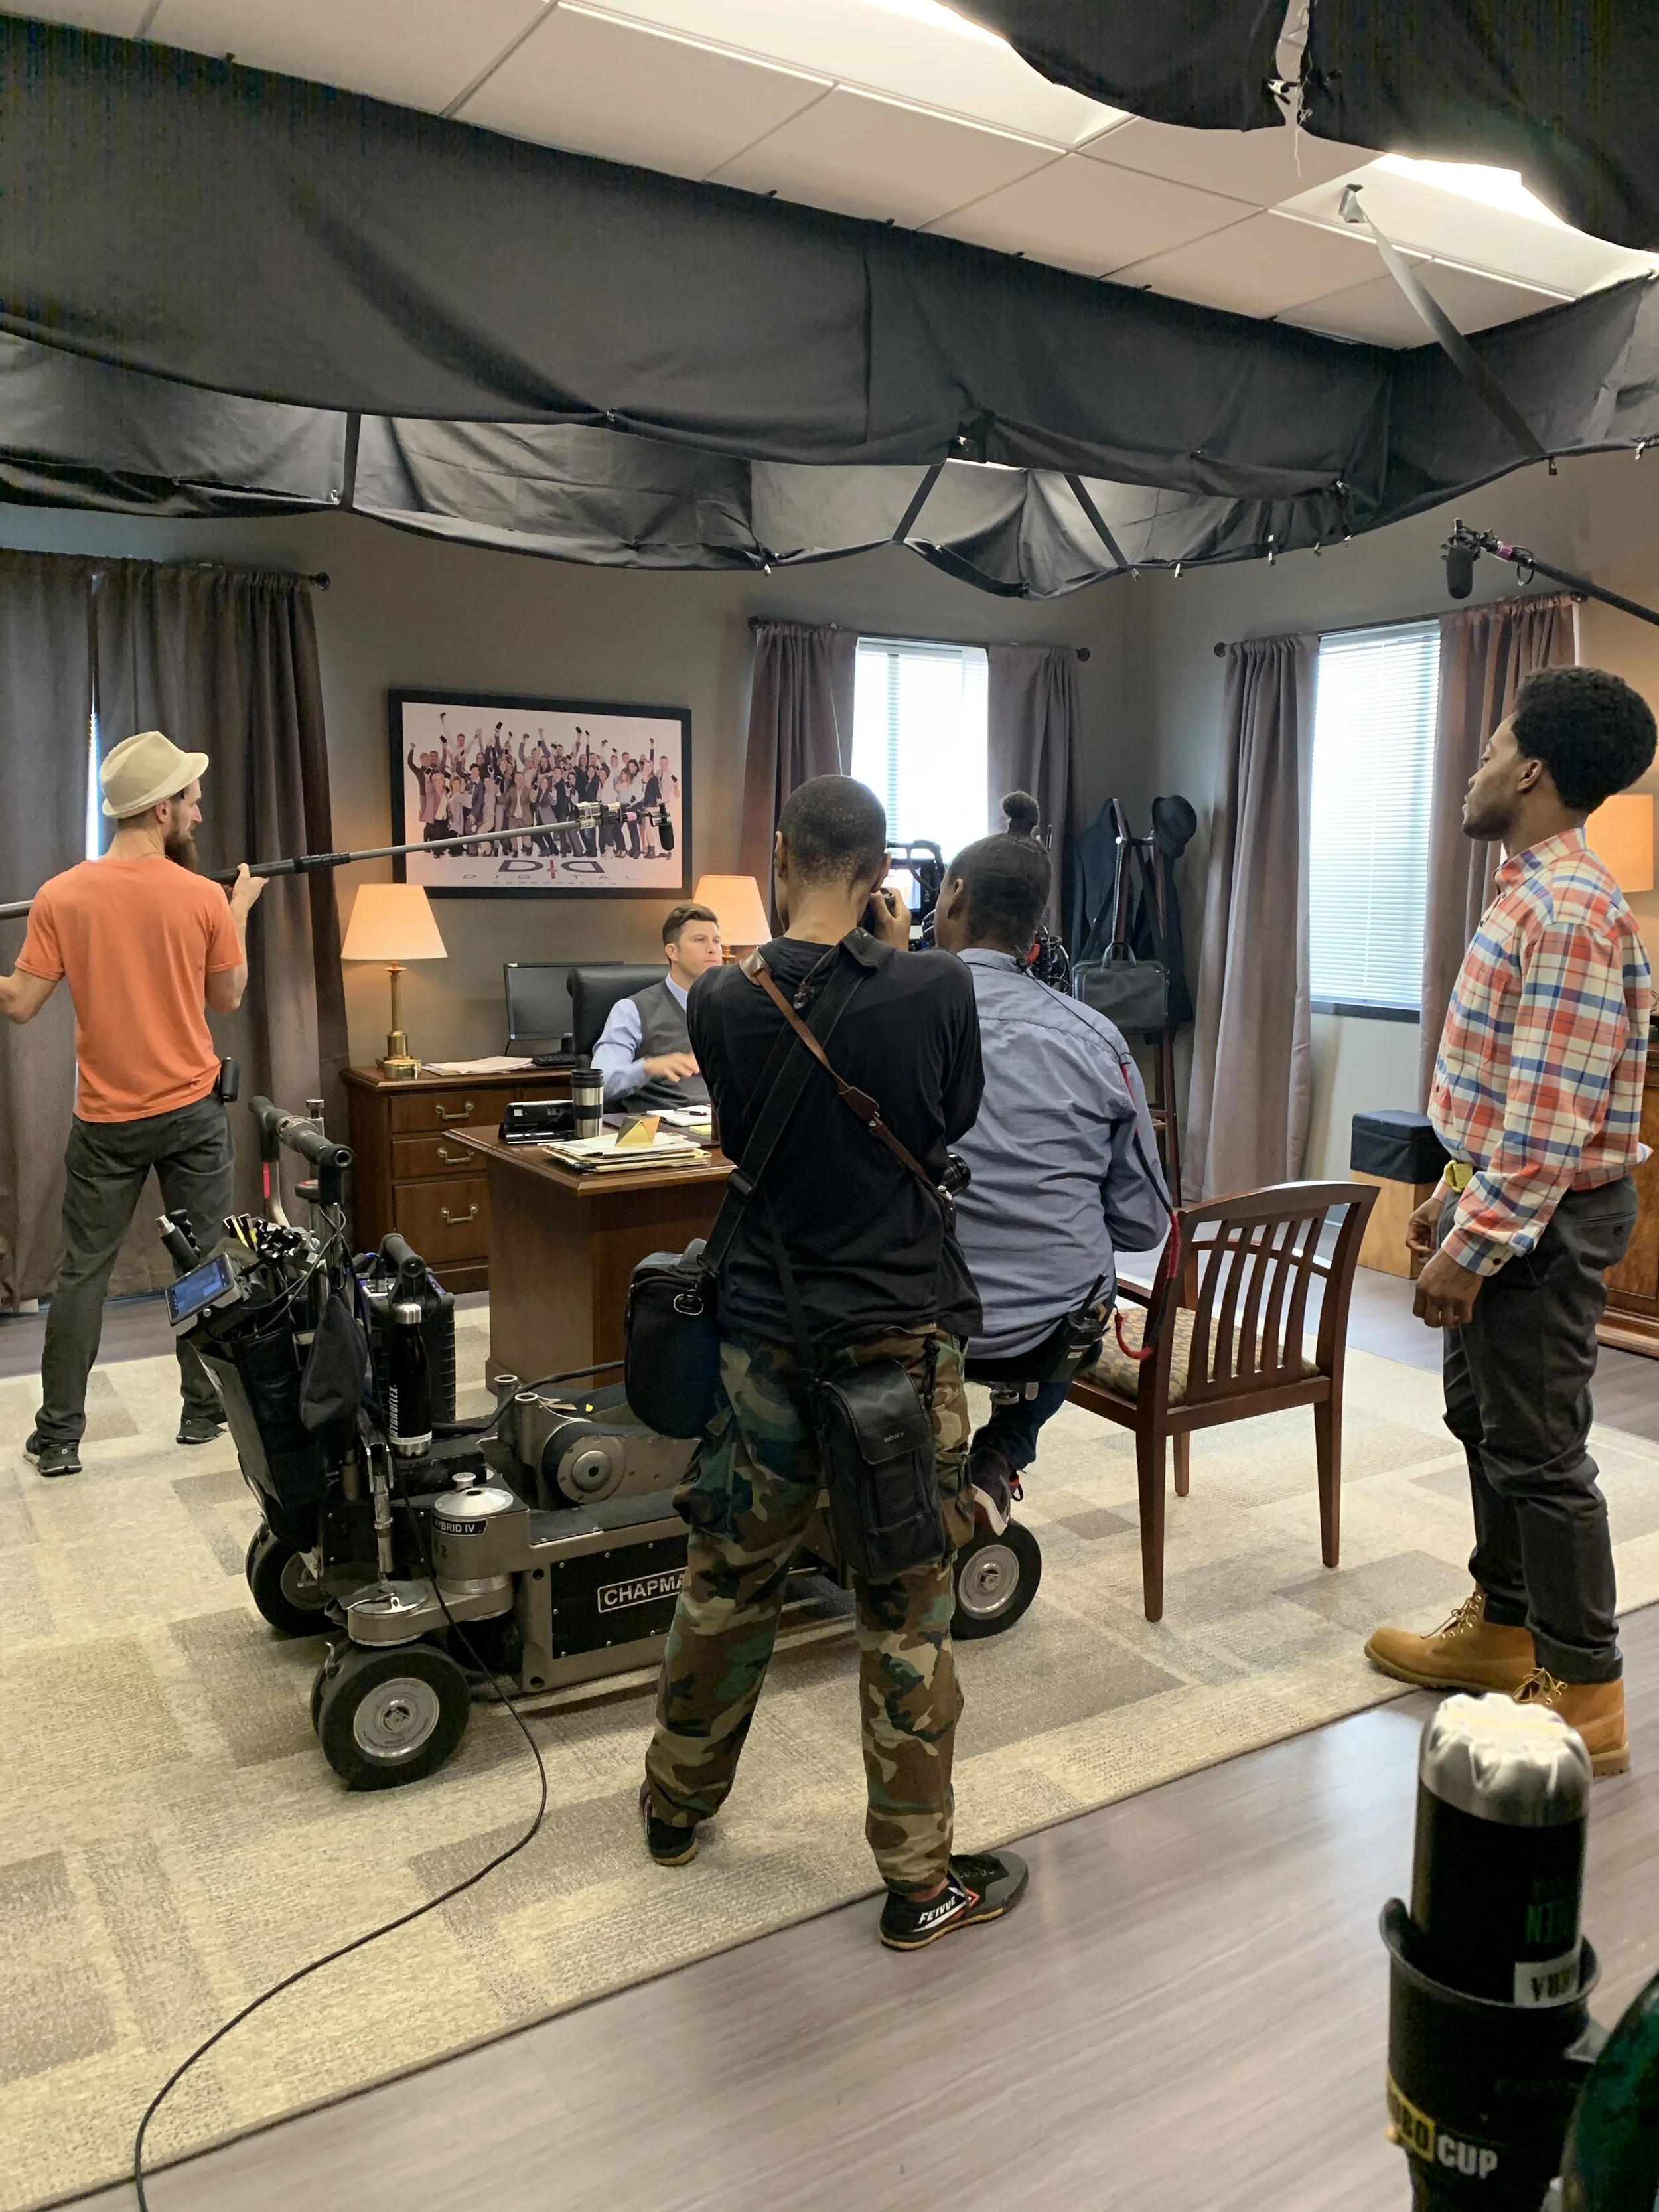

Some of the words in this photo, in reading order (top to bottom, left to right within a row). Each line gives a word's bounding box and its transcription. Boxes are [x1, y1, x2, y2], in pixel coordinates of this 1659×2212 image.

[883, 1431, 904, 1443] SONY
[434, 1518, 463, 1533] HYBRID
[465, 1524, 475, 1533] IV
[1437, 2134, 1498, 2179] CUP
